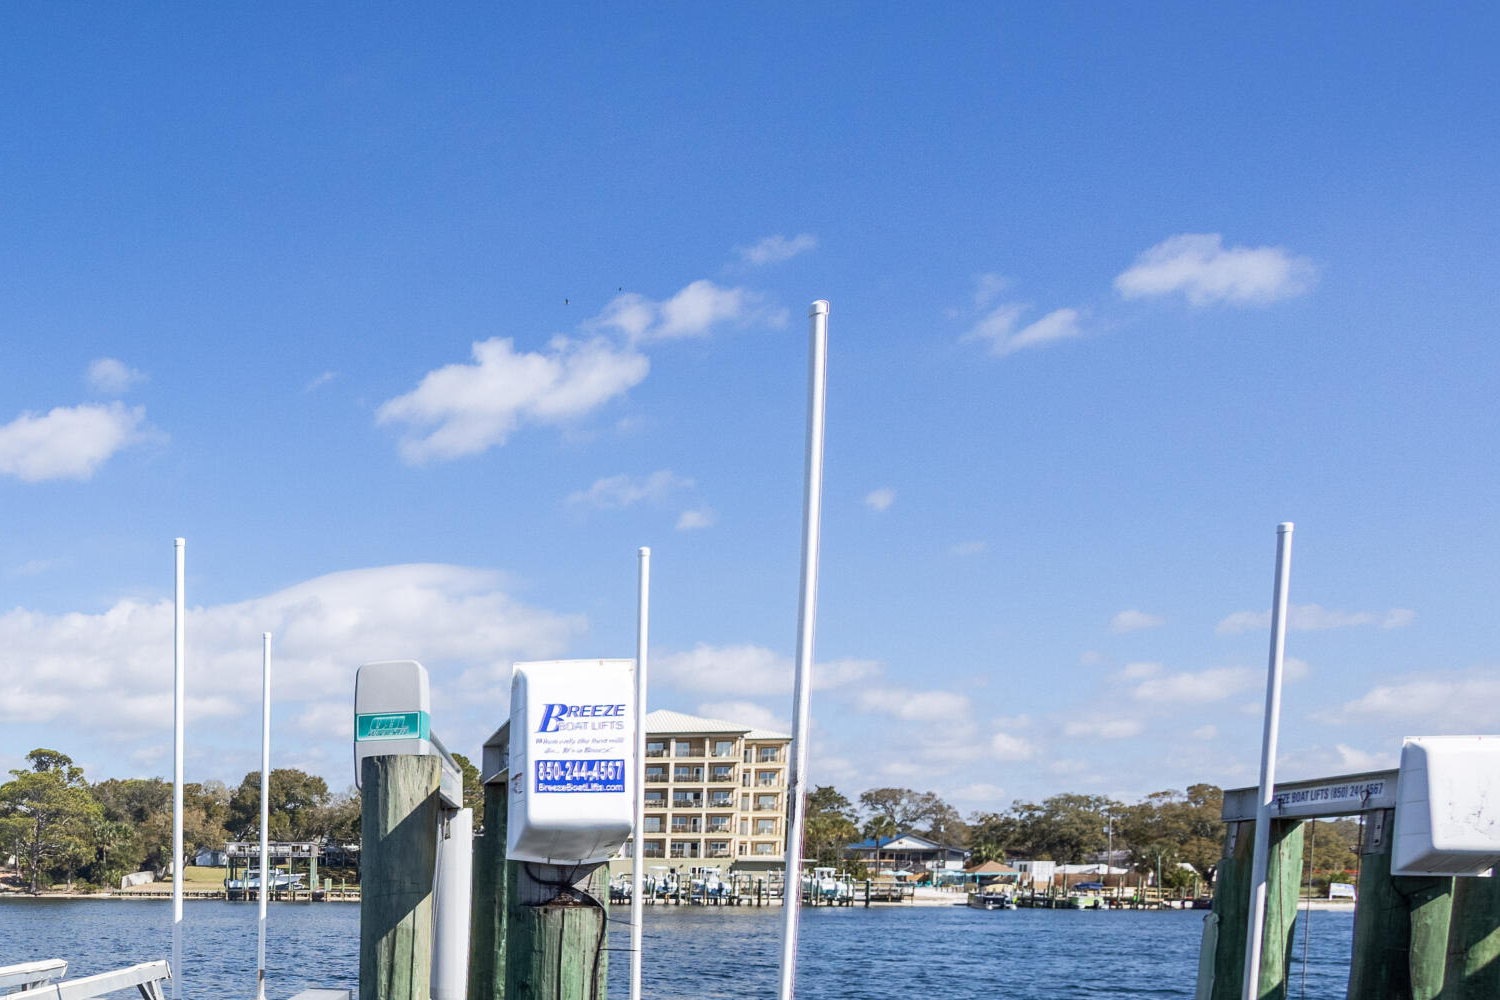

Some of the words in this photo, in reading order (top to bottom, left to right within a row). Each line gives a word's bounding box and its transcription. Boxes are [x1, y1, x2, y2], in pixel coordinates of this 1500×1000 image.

[558, 721, 589, 731] BOAT
[591, 720, 625, 730] LIFTS
[538, 761, 623, 781] 850-244-4567
[538, 783, 623, 791] BreezeBoatLifts.com
[1292, 790, 1309, 803] BOAT
[1310, 787, 1329, 801] LIFTS
[1330, 784, 1348, 799] (850)
